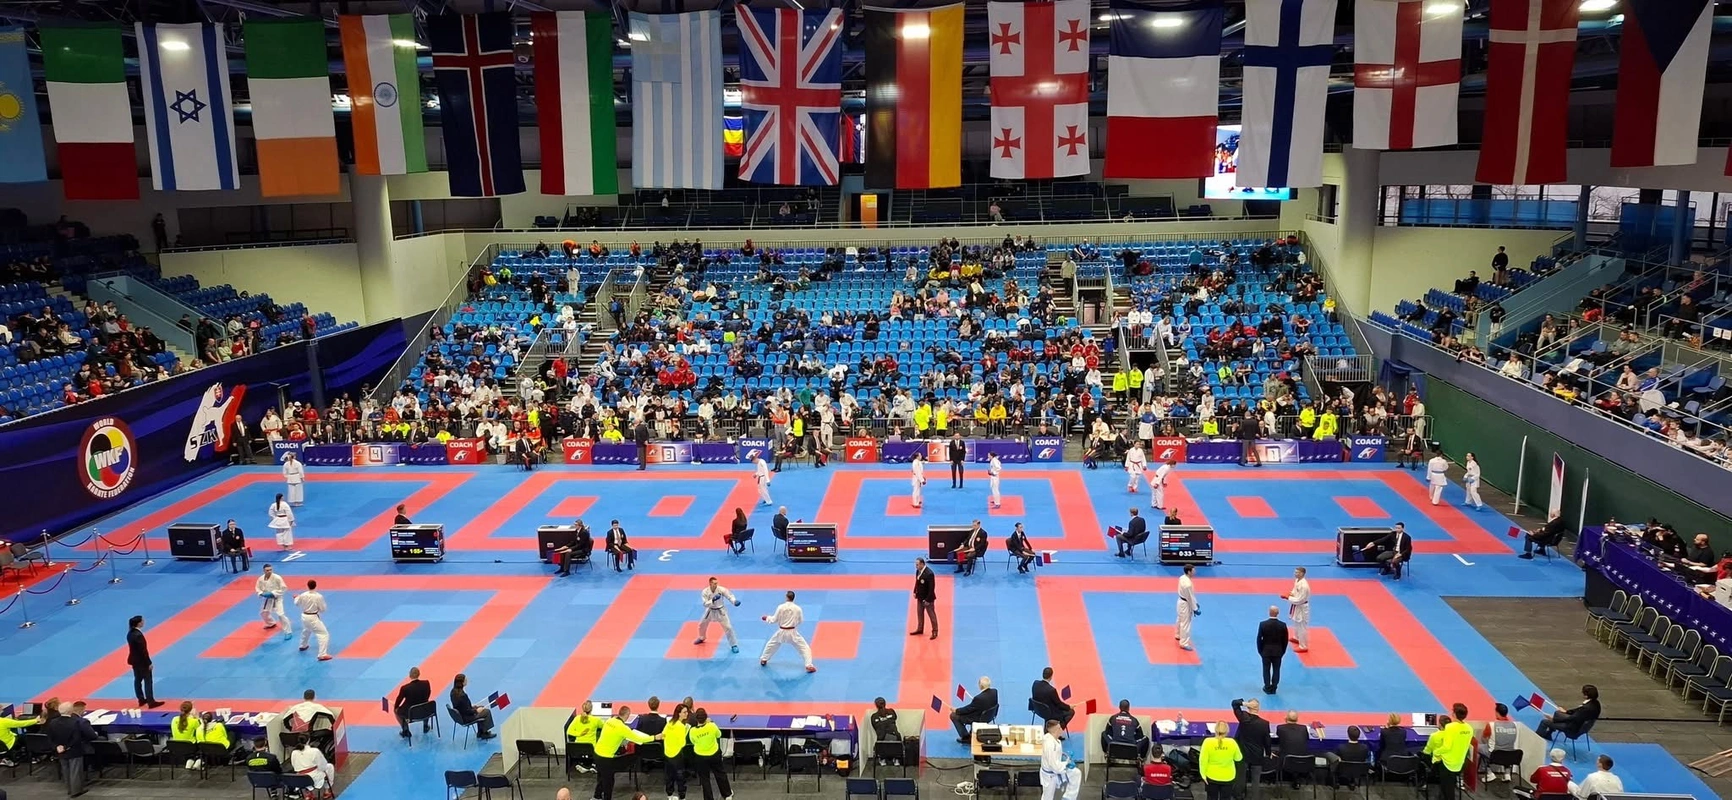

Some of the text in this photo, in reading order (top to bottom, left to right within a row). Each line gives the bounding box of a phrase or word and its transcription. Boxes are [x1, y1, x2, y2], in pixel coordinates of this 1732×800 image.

[93, 418, 114, 430] WORLD
[190, 429, 219, 449] SZK
[94, 447, 124, 470] WKF
[87, 467, 135, 498] KARATE FEDERATION
